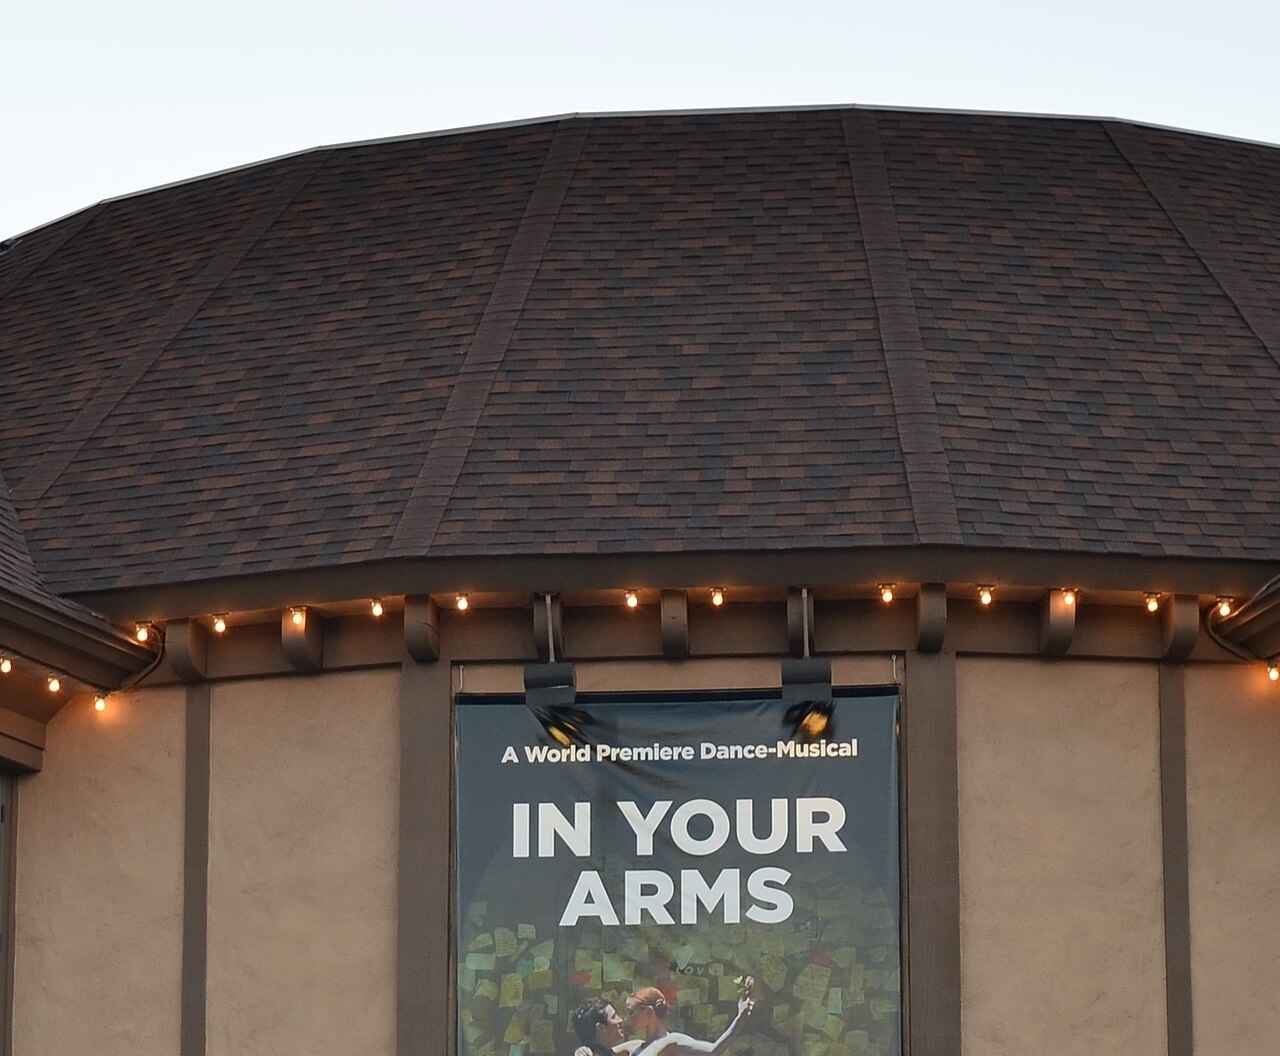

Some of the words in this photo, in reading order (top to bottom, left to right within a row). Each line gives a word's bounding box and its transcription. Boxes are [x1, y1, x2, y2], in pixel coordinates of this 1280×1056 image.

[501, 746, 519, 764] A
[524, 744, 591, 763] World
[596, 742, 695, 762] Premiere
[700, 738, 859, 760] Dance-Musical
[512, 801, 591, 858] IN
[616, 796, 848, 857] YOUR
[559, 866, 794, 927] ARMS
